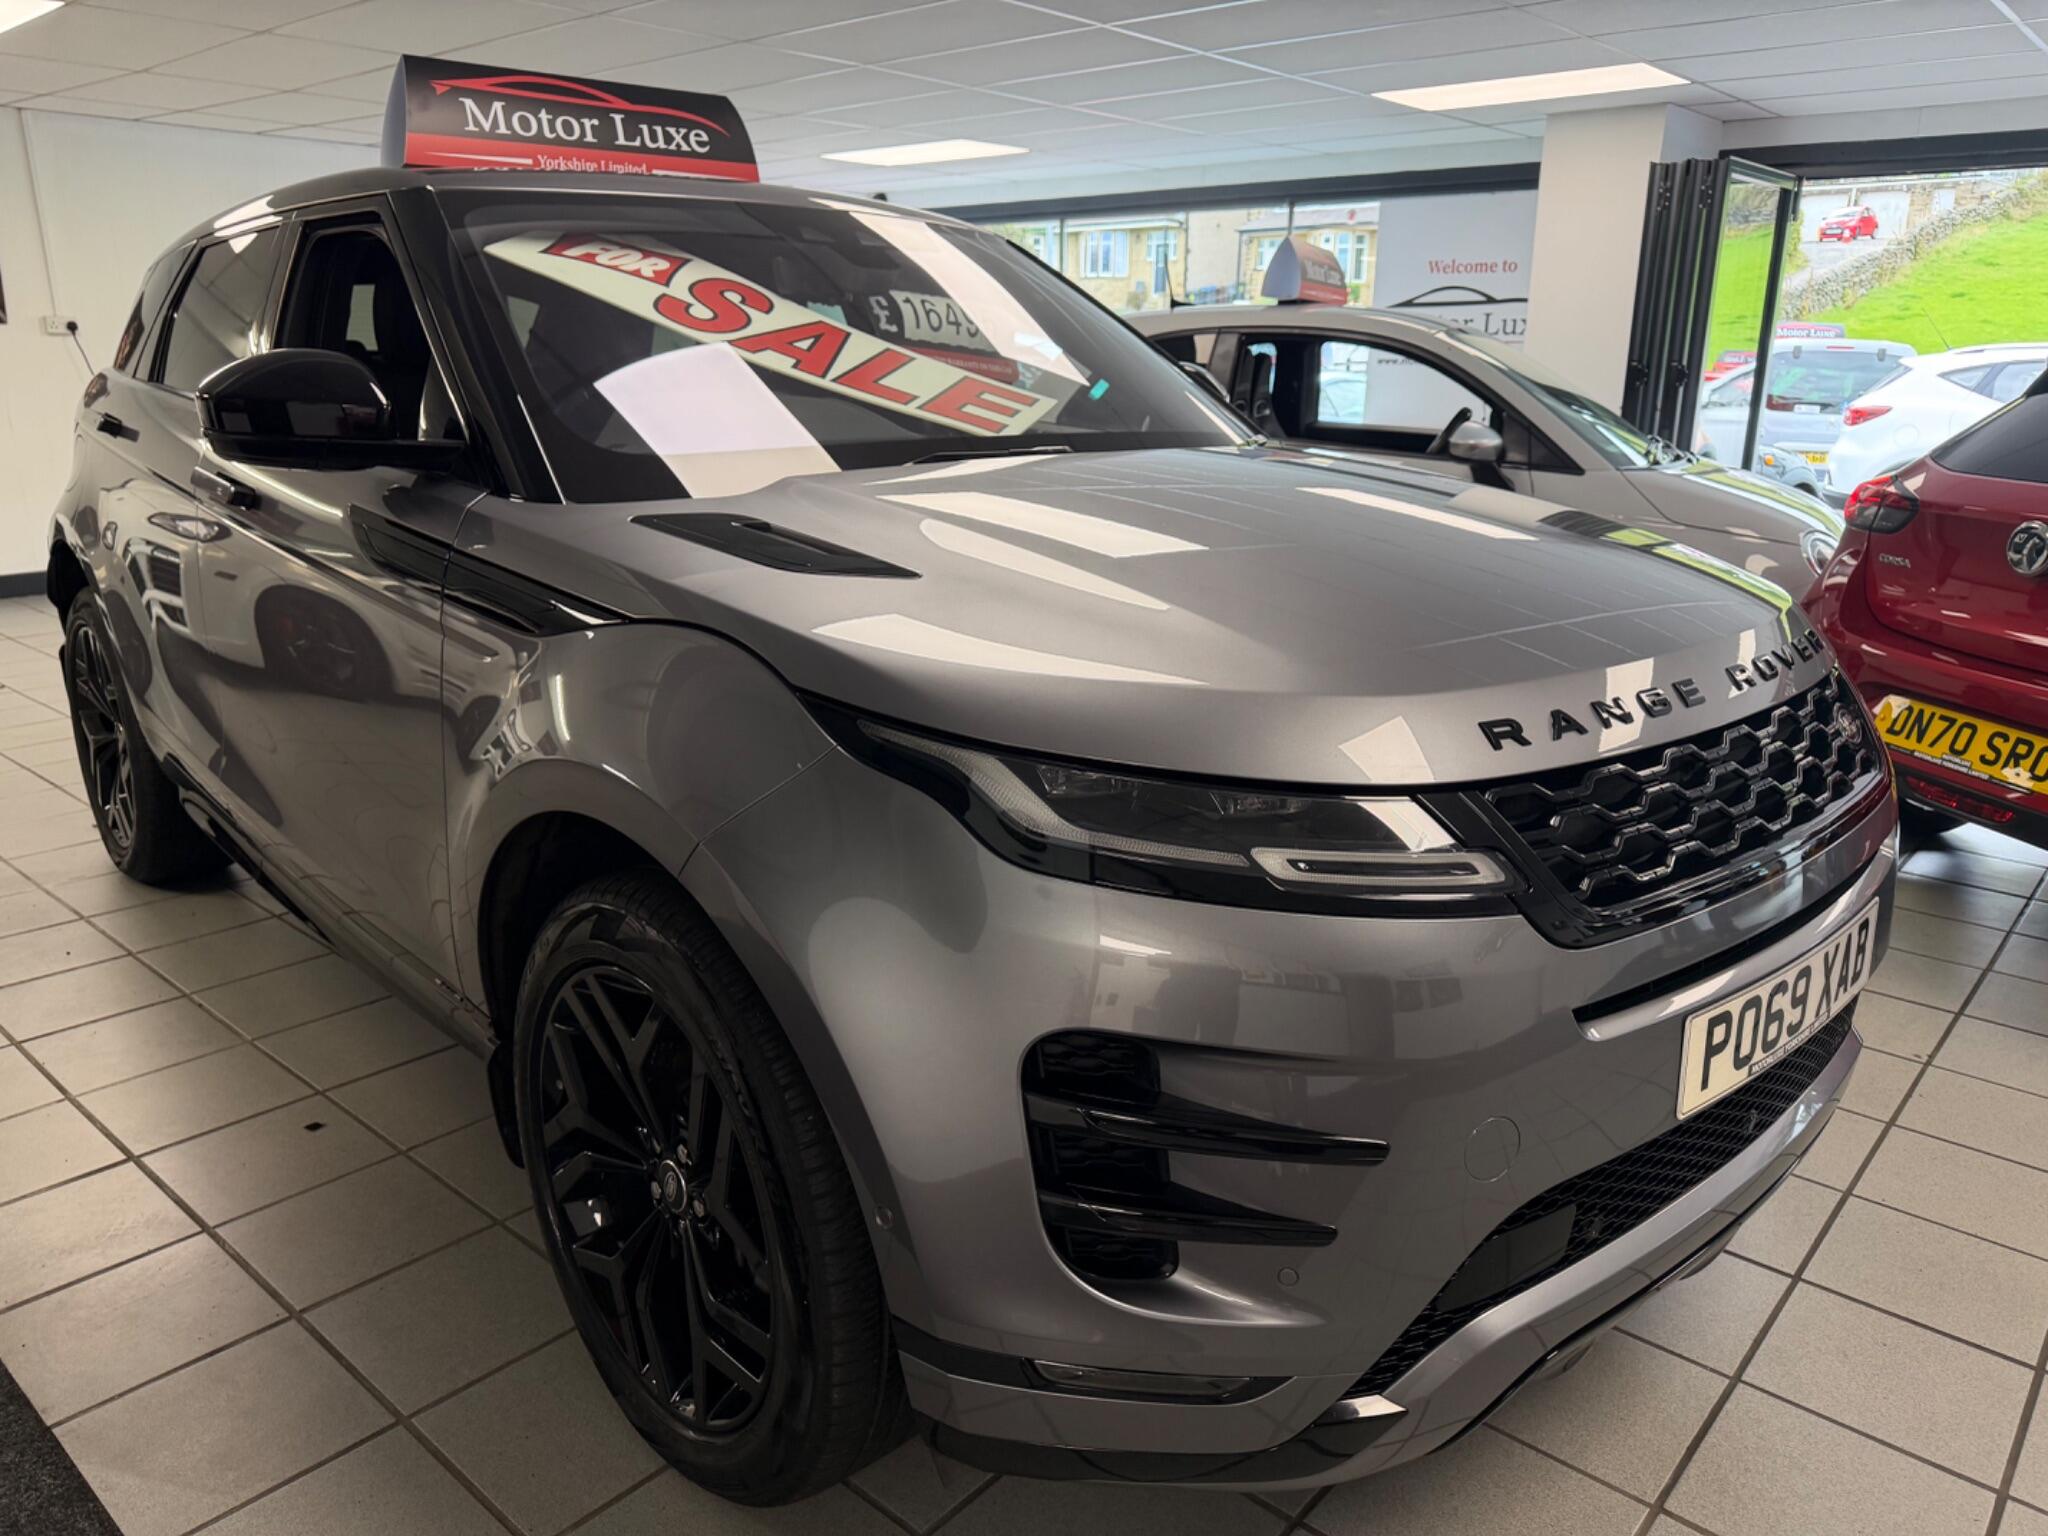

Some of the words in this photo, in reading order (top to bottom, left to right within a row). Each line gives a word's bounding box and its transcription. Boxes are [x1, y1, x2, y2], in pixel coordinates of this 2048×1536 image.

[458, 97, 598, 143] Motor
[609, 113, 711, 153] Luxe
[537, 154, 597, 171] Yorkshire
[562, 241, 671, 277] FOR
[1428, 258, 1498, 274] Welcome
[1502, 260, 1518, 273] to
[653, 278, 1043, 434] SALE
[1478, 678, 1706, 751] RANGE
[1725, 629, 1824, 691] ROVER
[1885, 704, 1978, 756] DN70
[1700, 965, 1812, 1092] PO69
[1815, 916, 1869, 1020] XAB
